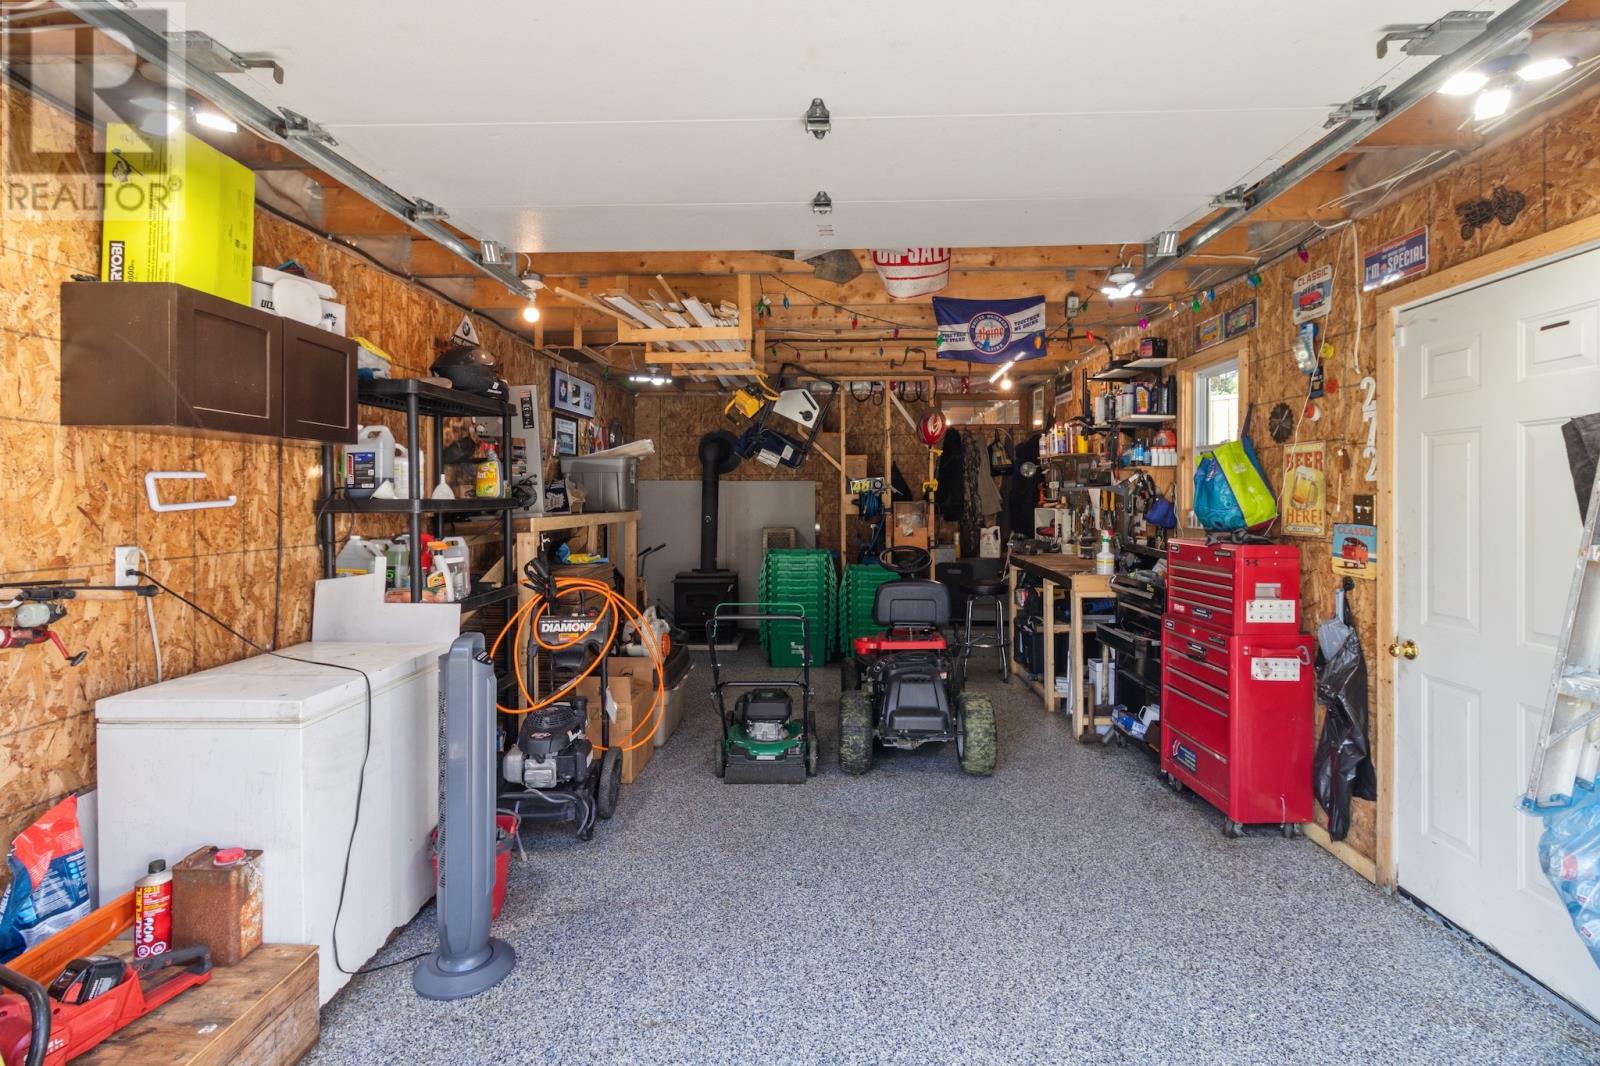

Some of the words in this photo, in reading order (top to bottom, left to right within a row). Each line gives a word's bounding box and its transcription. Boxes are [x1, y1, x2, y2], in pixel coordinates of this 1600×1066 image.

[110, 242, 123, 281] RYOBI
[1366, 262, 1380, 281] I'M
[1388, 244, 1425, 273] SPECIAL
[1297, 266, 1329, 287] CLASSIC
[1283, 450, 1323, 472] BEER
[1286, 509, 1323, 526] HERE!
[541, 622, 597, 633] DIAMOND
[135, 887, 143, 945] TRUFUEL
